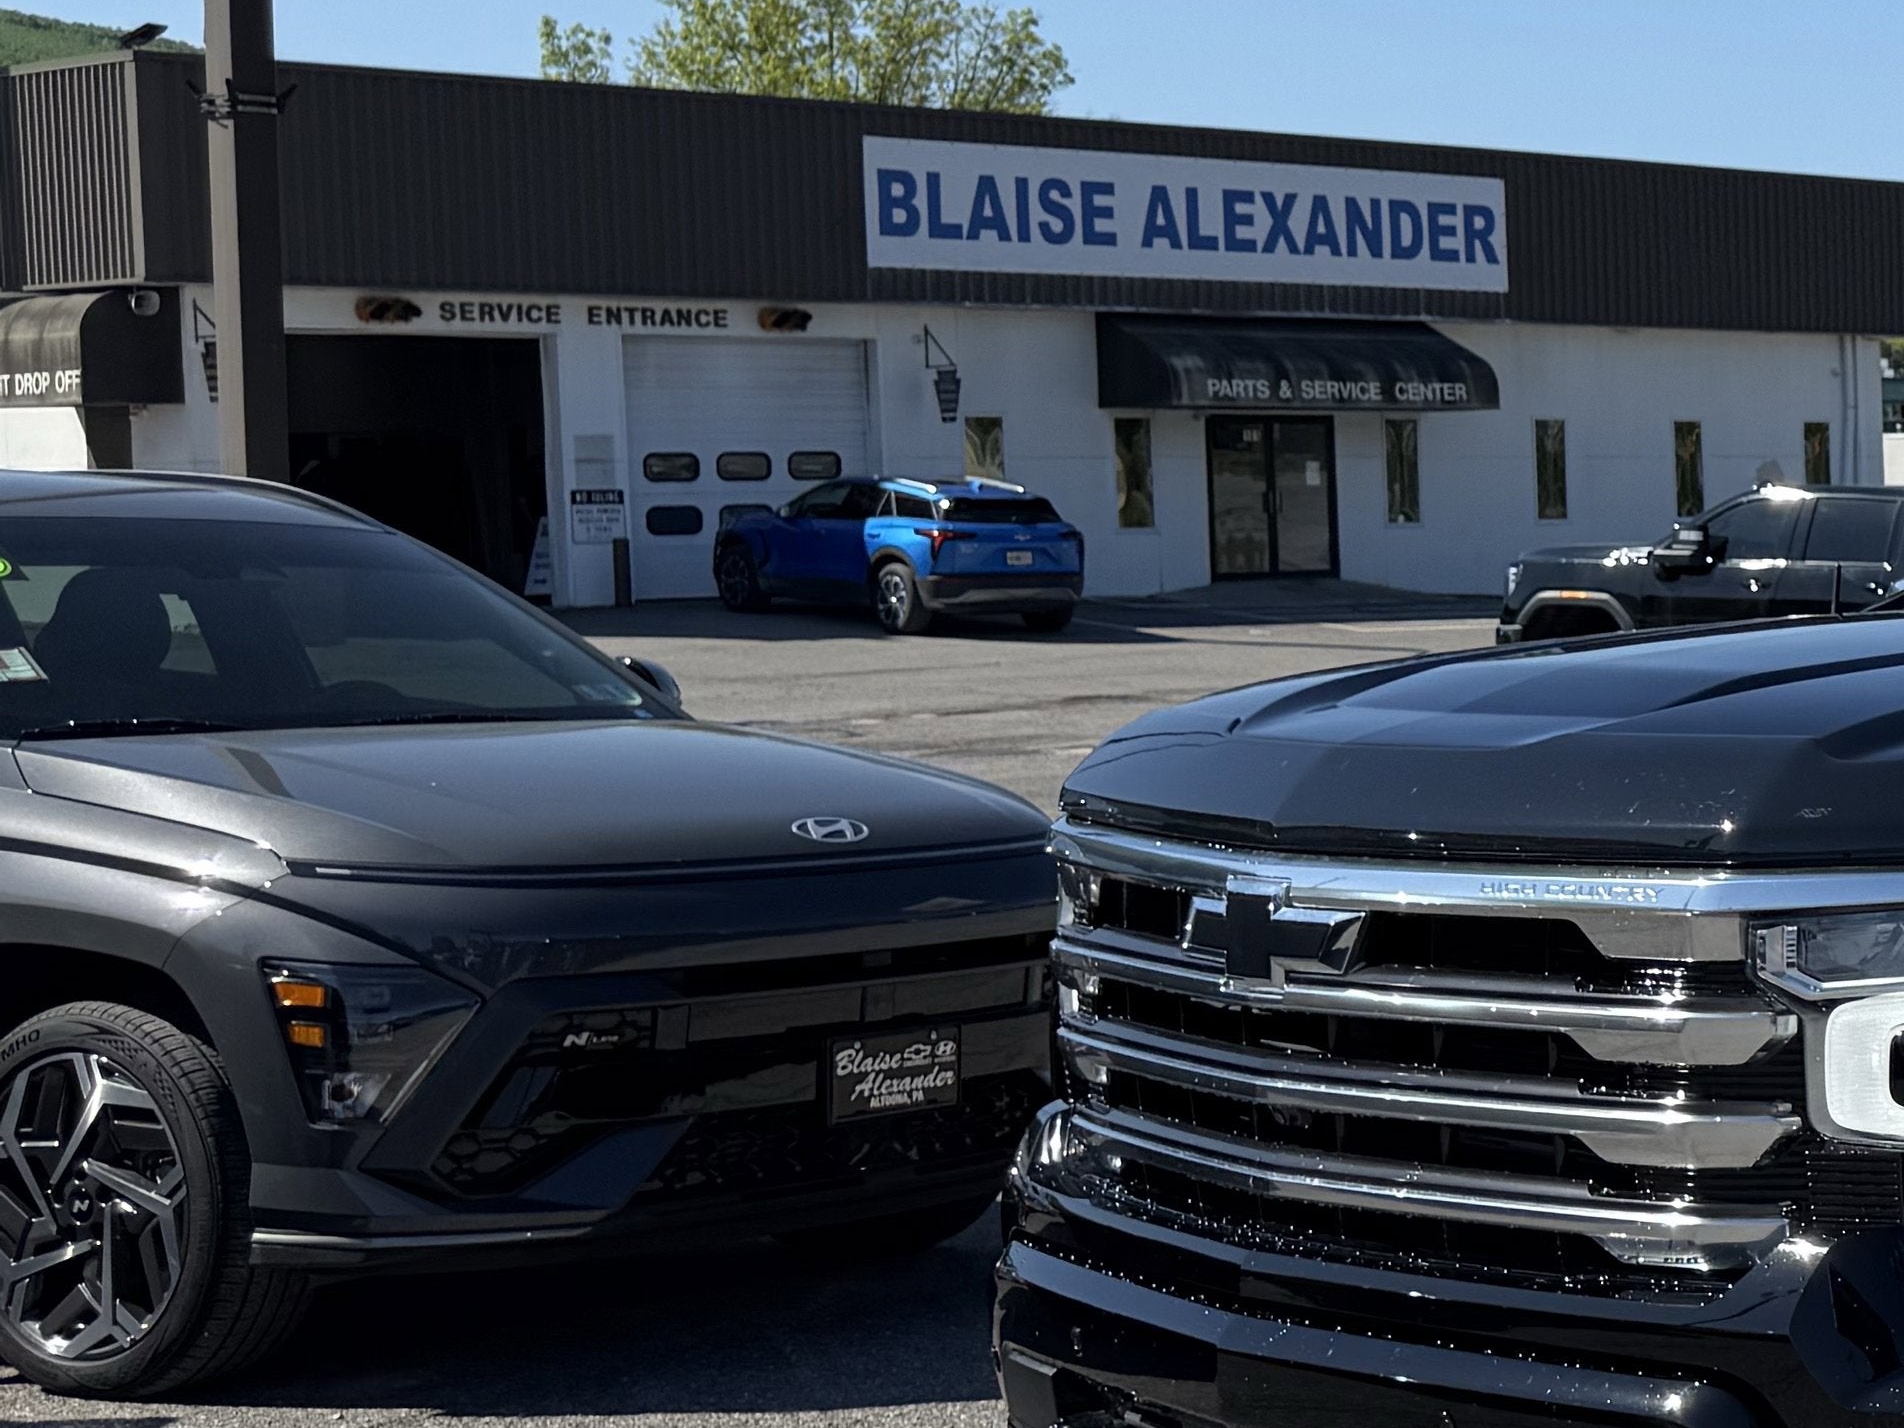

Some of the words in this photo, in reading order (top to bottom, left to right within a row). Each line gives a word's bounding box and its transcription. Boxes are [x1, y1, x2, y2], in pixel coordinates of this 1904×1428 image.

[875, 168, 1118, 247] BLAISE
[1140, 184, 1501, 265] ALEXANDER
[439, 300, 562, 324] SERVICE
[586, 304, 729, 329] ENTRANCE
[15, 372, 50, 396] DROP
[55, 369, 82, 394] OFF
[1207, 379, 1271, 399] PARTS
[1279, 380, 1293, 399] &
[1301, 379, 1383, 401] SERVICE
[1395, 382, 1468, 402] CENTER
[1480, 881, 1536, 899] HIGH
[1544, 882, 1665, 904] COUNTRY
[835, 1048, 902, 1076] Blaise
[851, 1065, 956, 1101] Alexander
